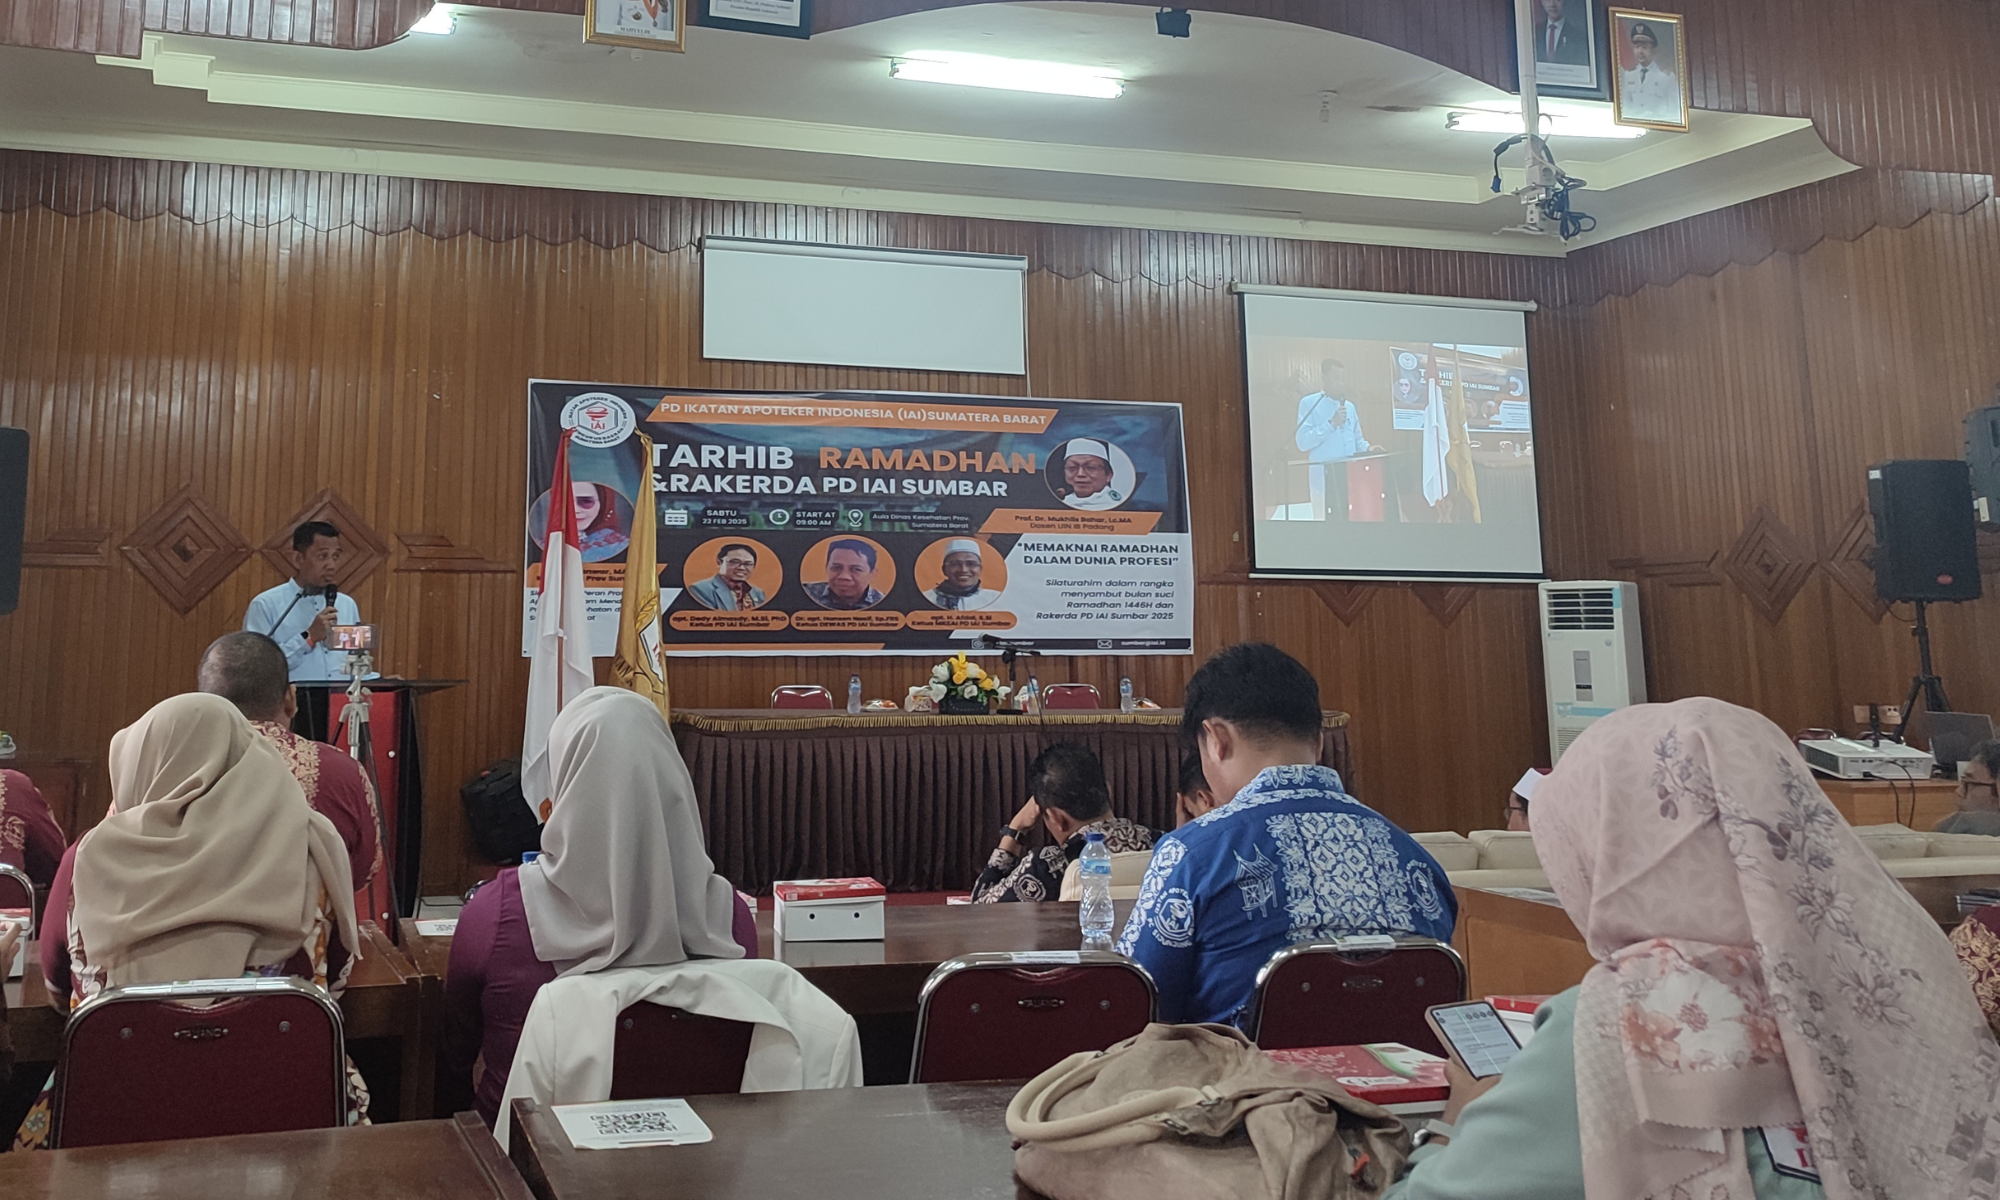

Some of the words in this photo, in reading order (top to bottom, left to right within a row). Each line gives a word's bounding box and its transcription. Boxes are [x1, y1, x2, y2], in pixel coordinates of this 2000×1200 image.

[660, 403, 680, 413] PD
[684, 404, 739, 414] IKATAN
[742, 405, 814, 417] APOTEKER
[817, 407, 893, 419] INDONESIA
[1003, 414, 1046, 425] BARAT
[591, 422, 605, 430] IAI
[652, 443, 794, 470] TARHIB
[819, 447, 1036, 474] RAMADHAN
[652, 473, 817, 495] &RAKERDA
[823, 477, 857, 493] PD
[863, 478, 896, 494] IAI
[902, 479, 1008, 497] SUMBAR
[707, 509, 737, 517] SABTU
[1083, 524, 1114, 532] Padang
[1101, 544, 1178, 554] RAMADHAN
[1023, 555, 1071, 565] DALAM
[1074, 556, 1117, 566] DUNIA
[1045, 579, 1102, 587] Silaturahim
[1105, 579, 1136, 587] dalam
[1139, 580, 1174, 589] rangka
[1060, 591, 1122, 599] menyambut
[1066, 601, 1121, 609] Ramadhan
[1124, 601, 1153, 609] 1446H
[1155, 601, 1174, 609] dan
[1036, 612, 1077, 620] Rakerda
[1080, 612, 1093, 620] PD
[1095, 612, 1108, 620] IAI
[1110, 612, 1149, 620] Sumbar
[1151, 612, 1174, 620] 2025
